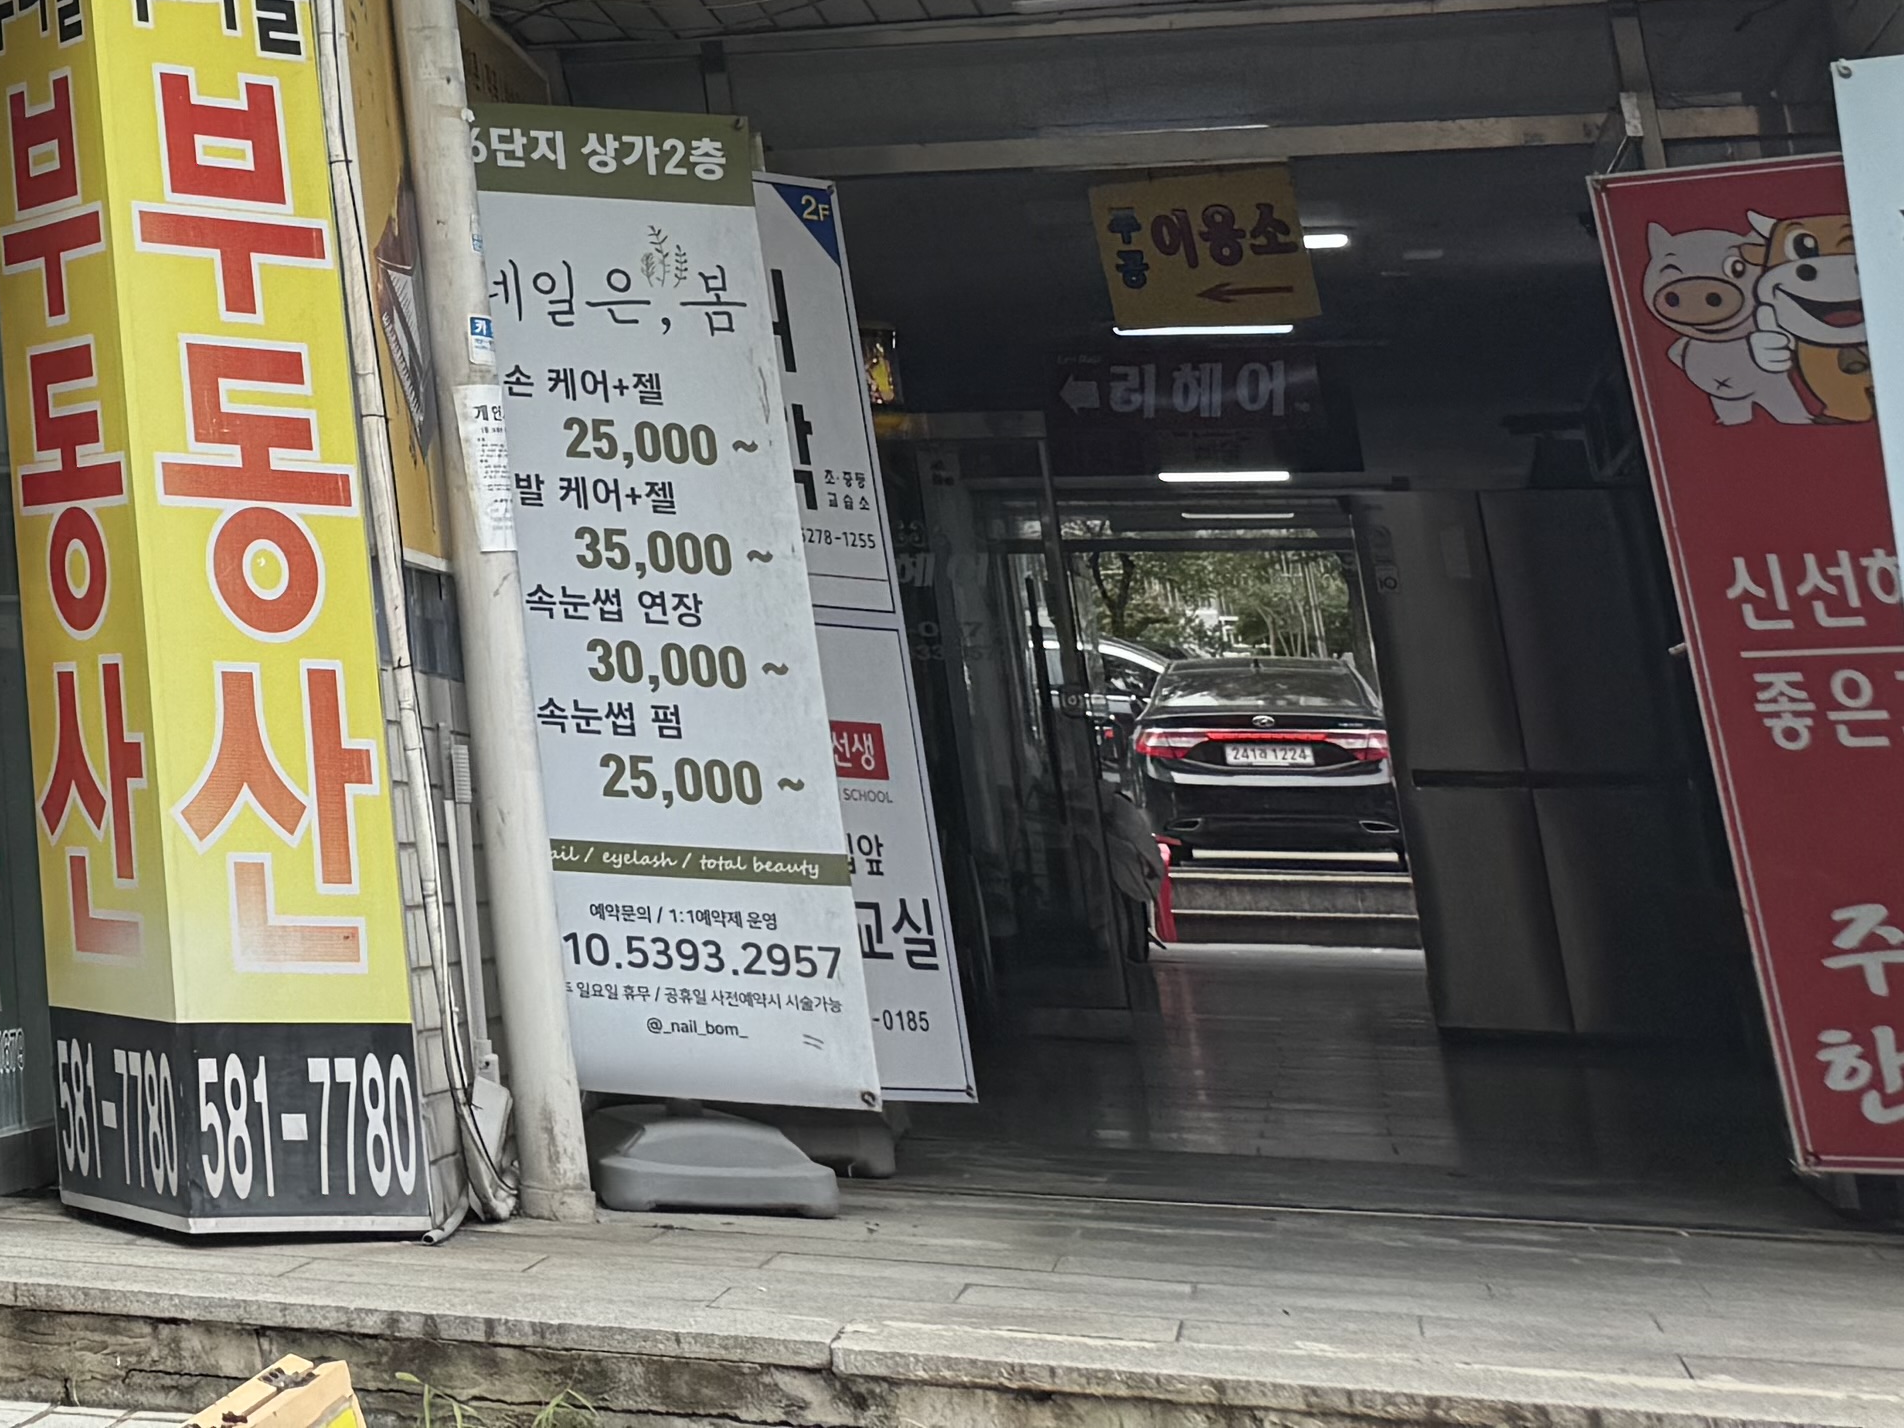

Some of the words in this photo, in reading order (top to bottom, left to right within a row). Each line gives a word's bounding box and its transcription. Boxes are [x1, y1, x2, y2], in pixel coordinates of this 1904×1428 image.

[580, 132, 728, 181] 상가2층
[801, 196, 830, 221] 2F
[1150, 203, 1298, 270] 이용소
[680, 265, 747, 336] 봄
[502, 365, 535, 398] 손
[547, 366, 664, 406] 케어+젤
[563, 417, 718, 468] 25,000
[514, 473, 544, 507] 발
[558, 477, 677, 515] 케어+젤
[130, 64, 378, 974] 부동산
[575, 526, 732, 578] 35,000
[524, 584, 623, 624] 속눈썹
[637, 590, 703, 628] 연장
[586, 639, 747, 693] 30,000
[537, 699, 636, 737] 속눈썹
[651, 702, 683, 740] 펌
[599, 754, 763, 809] 25,000
[843, 788, 892, 805] SCHOOL
[602, 849, 678, 869] eyelash
[699, 854, 747, 872] total
[753, 859, 820, 879] beauty
[589, 903, 652, 924] 예약문의
[669, 908, 743, 929] 1:1예약제
[747, 911, 778, 931] 운영
[576, 980, 619, 1000] 일요일
[622, 984, 651, 1003] 휴무
[664, 987, 707, 1006] 공휴일
[711, 988, 782, 1011] 사전예약시
[785, 993, 843, 1014] 시술가능
[647, 1017, 748, 1039] @_nail_bom_
[55, 1036, 179, 1203] 581-7780
[194, 1048, 417, 1203] 581-7780
